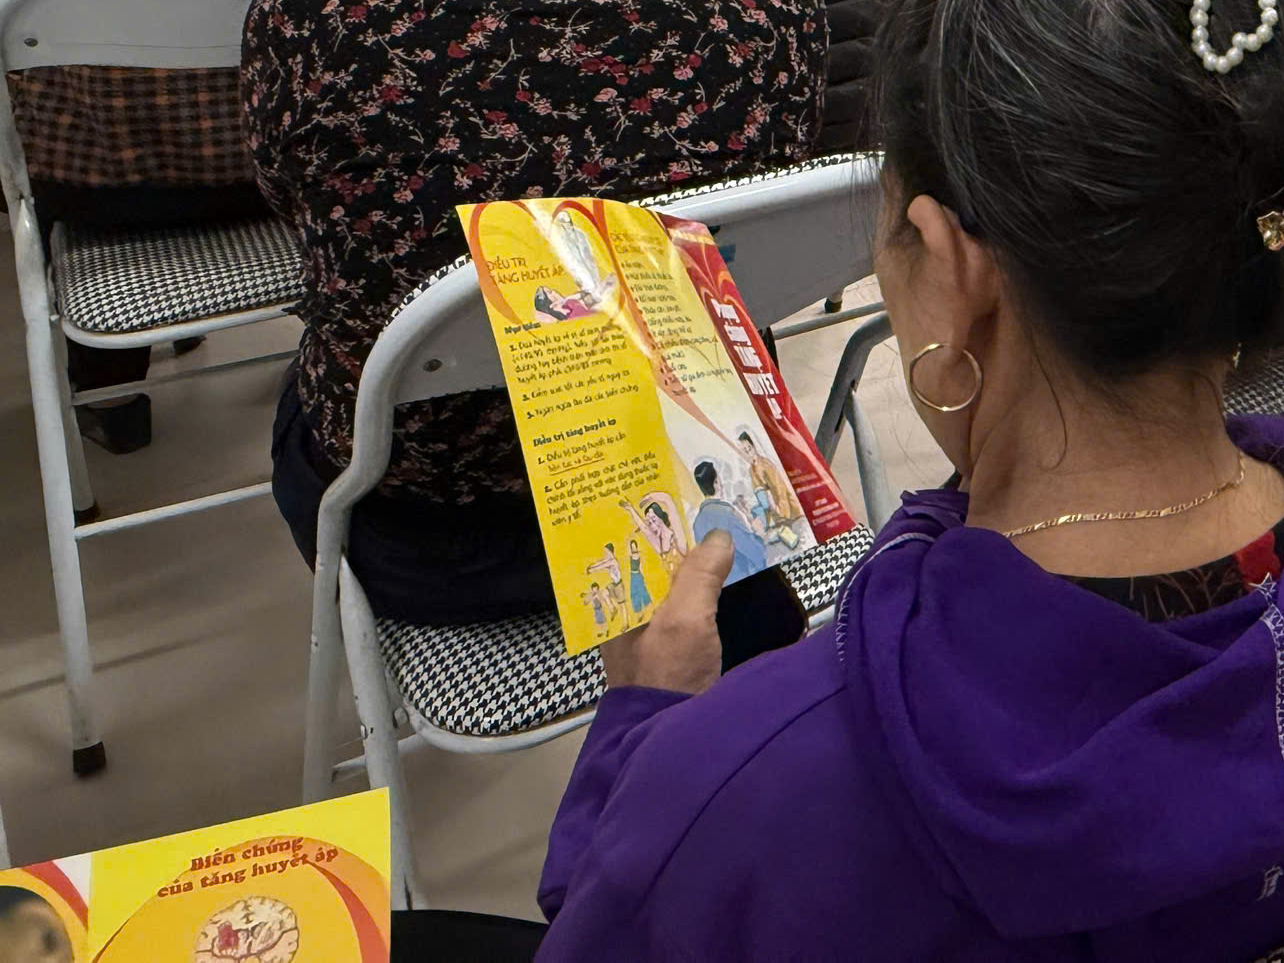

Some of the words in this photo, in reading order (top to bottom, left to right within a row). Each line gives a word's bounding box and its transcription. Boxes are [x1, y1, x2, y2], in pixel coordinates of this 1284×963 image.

[157, 879, 194, 898] của
[200, 868, 247, 889] tăng
[250, 852, 309, 878] huyết
[315, 846, 339, 863] áp
[190, 847, 236, 872] Biến
[242, 836, 304, 860] chứng
